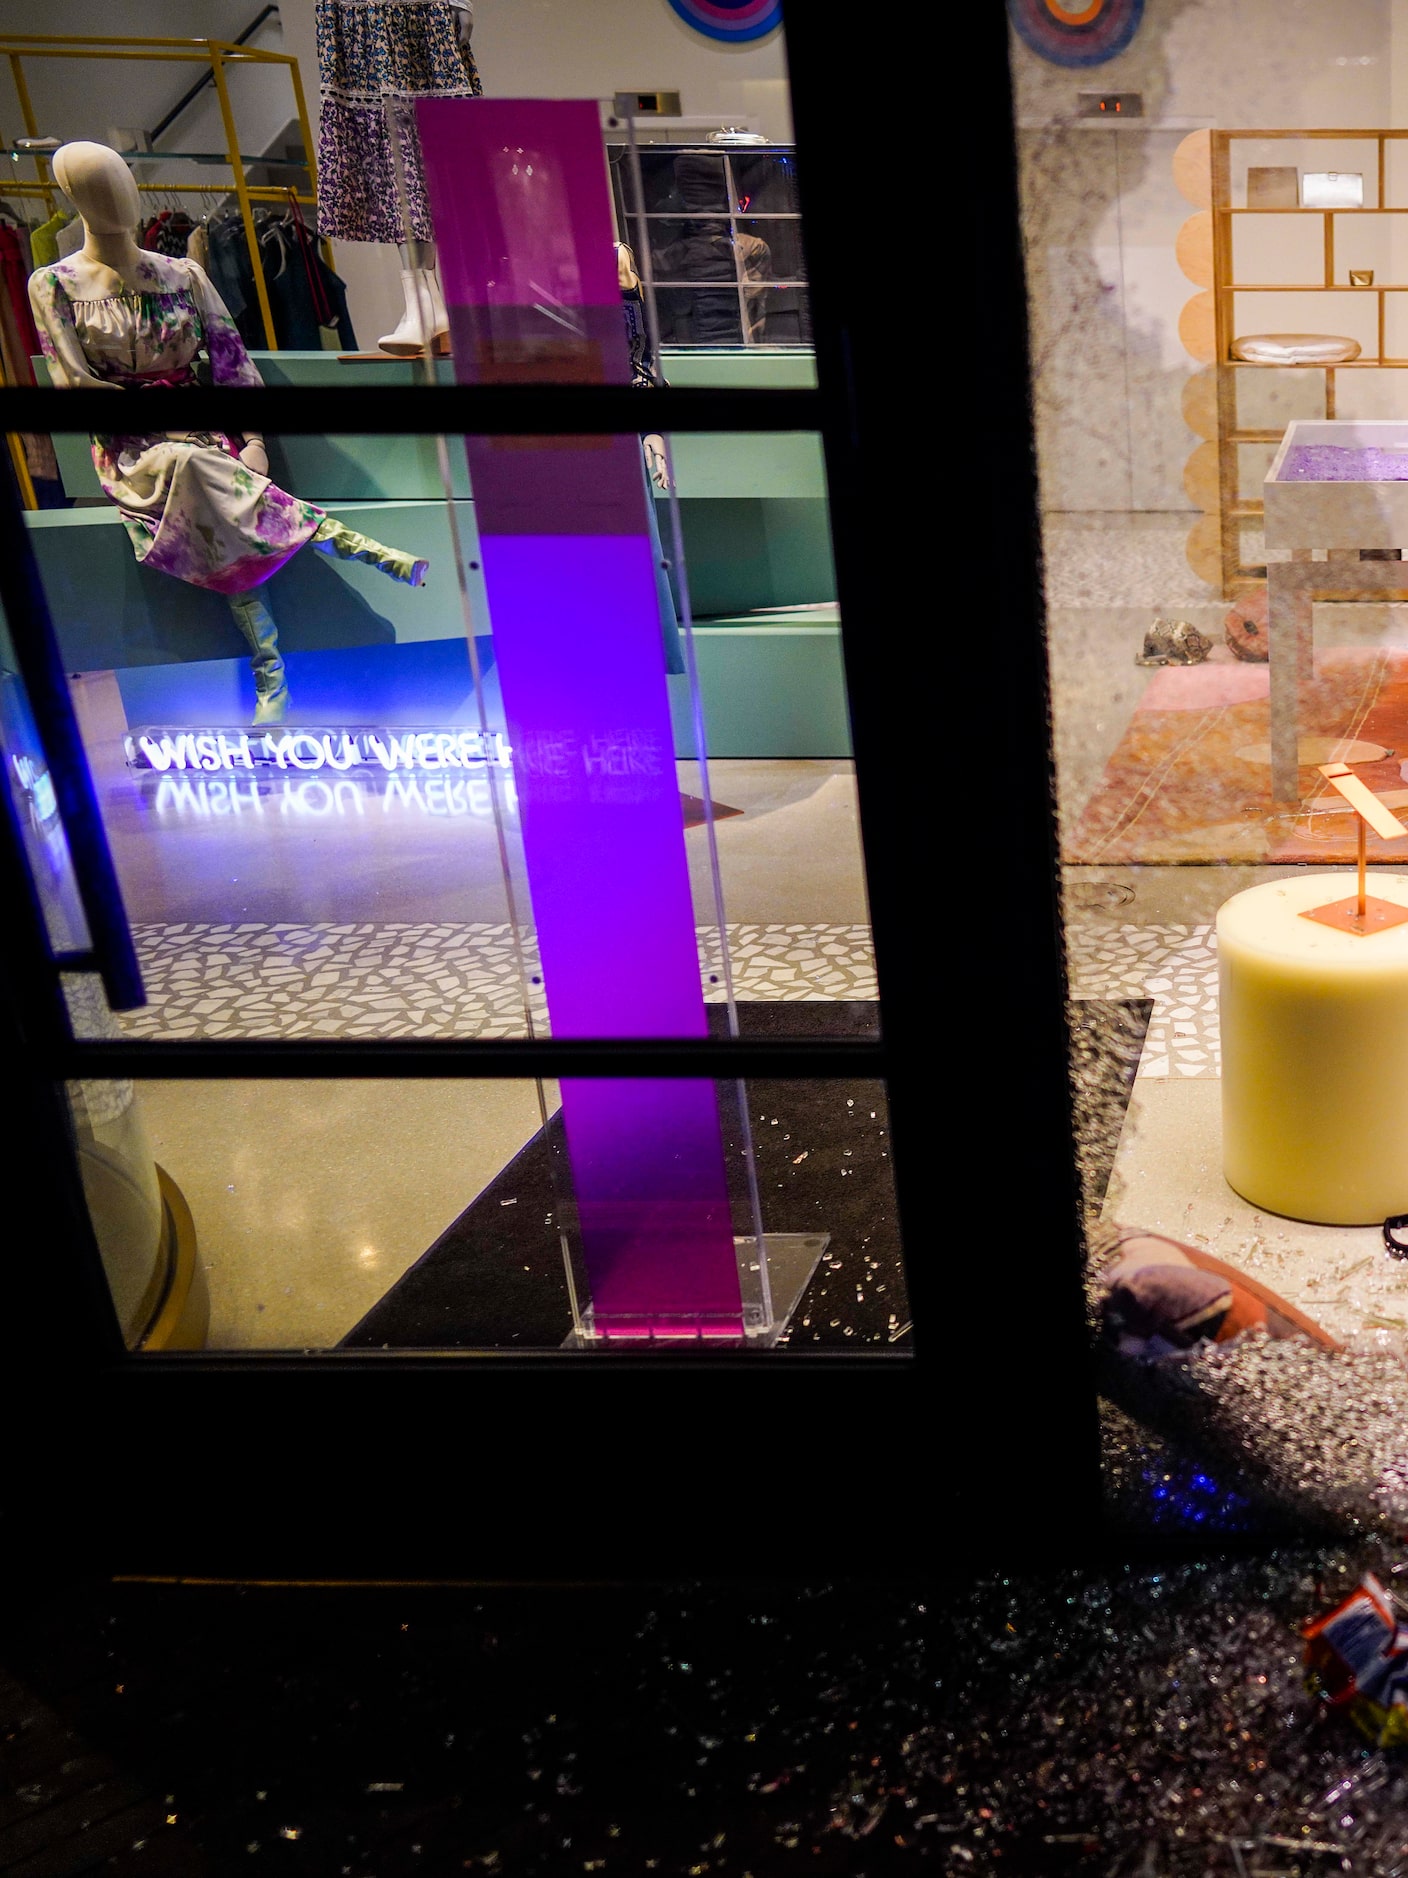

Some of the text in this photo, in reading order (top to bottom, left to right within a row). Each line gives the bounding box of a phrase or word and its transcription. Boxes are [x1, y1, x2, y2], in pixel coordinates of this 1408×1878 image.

[139, 734, 254, 770] WISH
[265, 733, 353, 769] YOU
[368, 732, 487, 770] WERE
